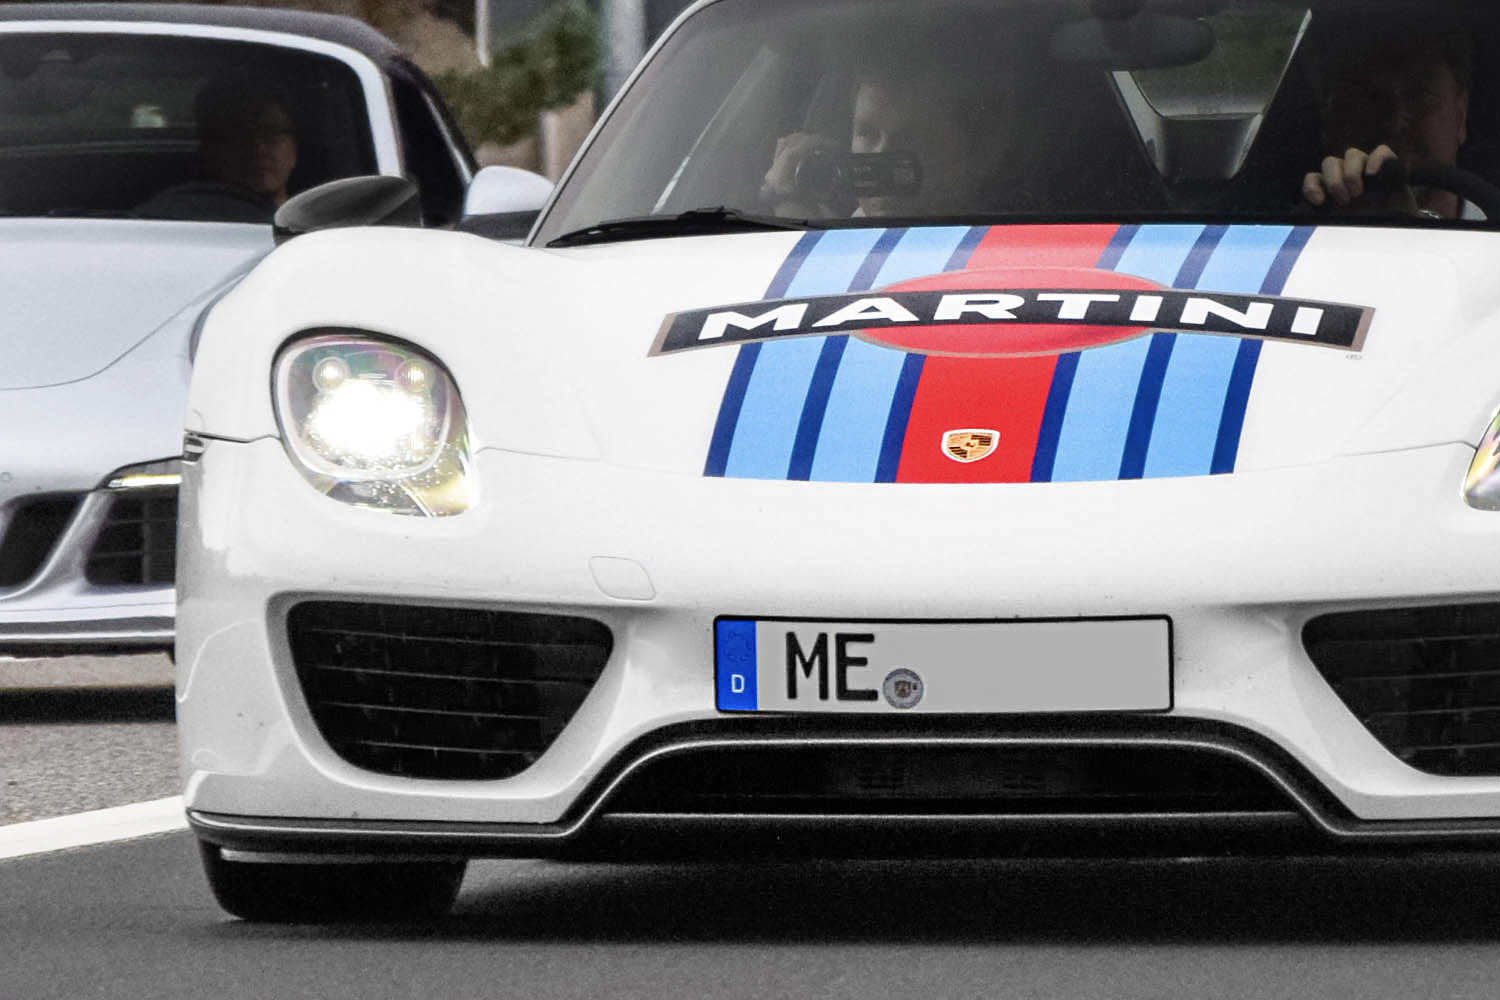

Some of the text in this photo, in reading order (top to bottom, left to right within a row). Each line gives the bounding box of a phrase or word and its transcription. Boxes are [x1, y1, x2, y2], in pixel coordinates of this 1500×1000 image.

[697, 293, 1325, 340] MARTINI
[731, 674, 745, 694] D
[786, 631, 878, 701] ME
